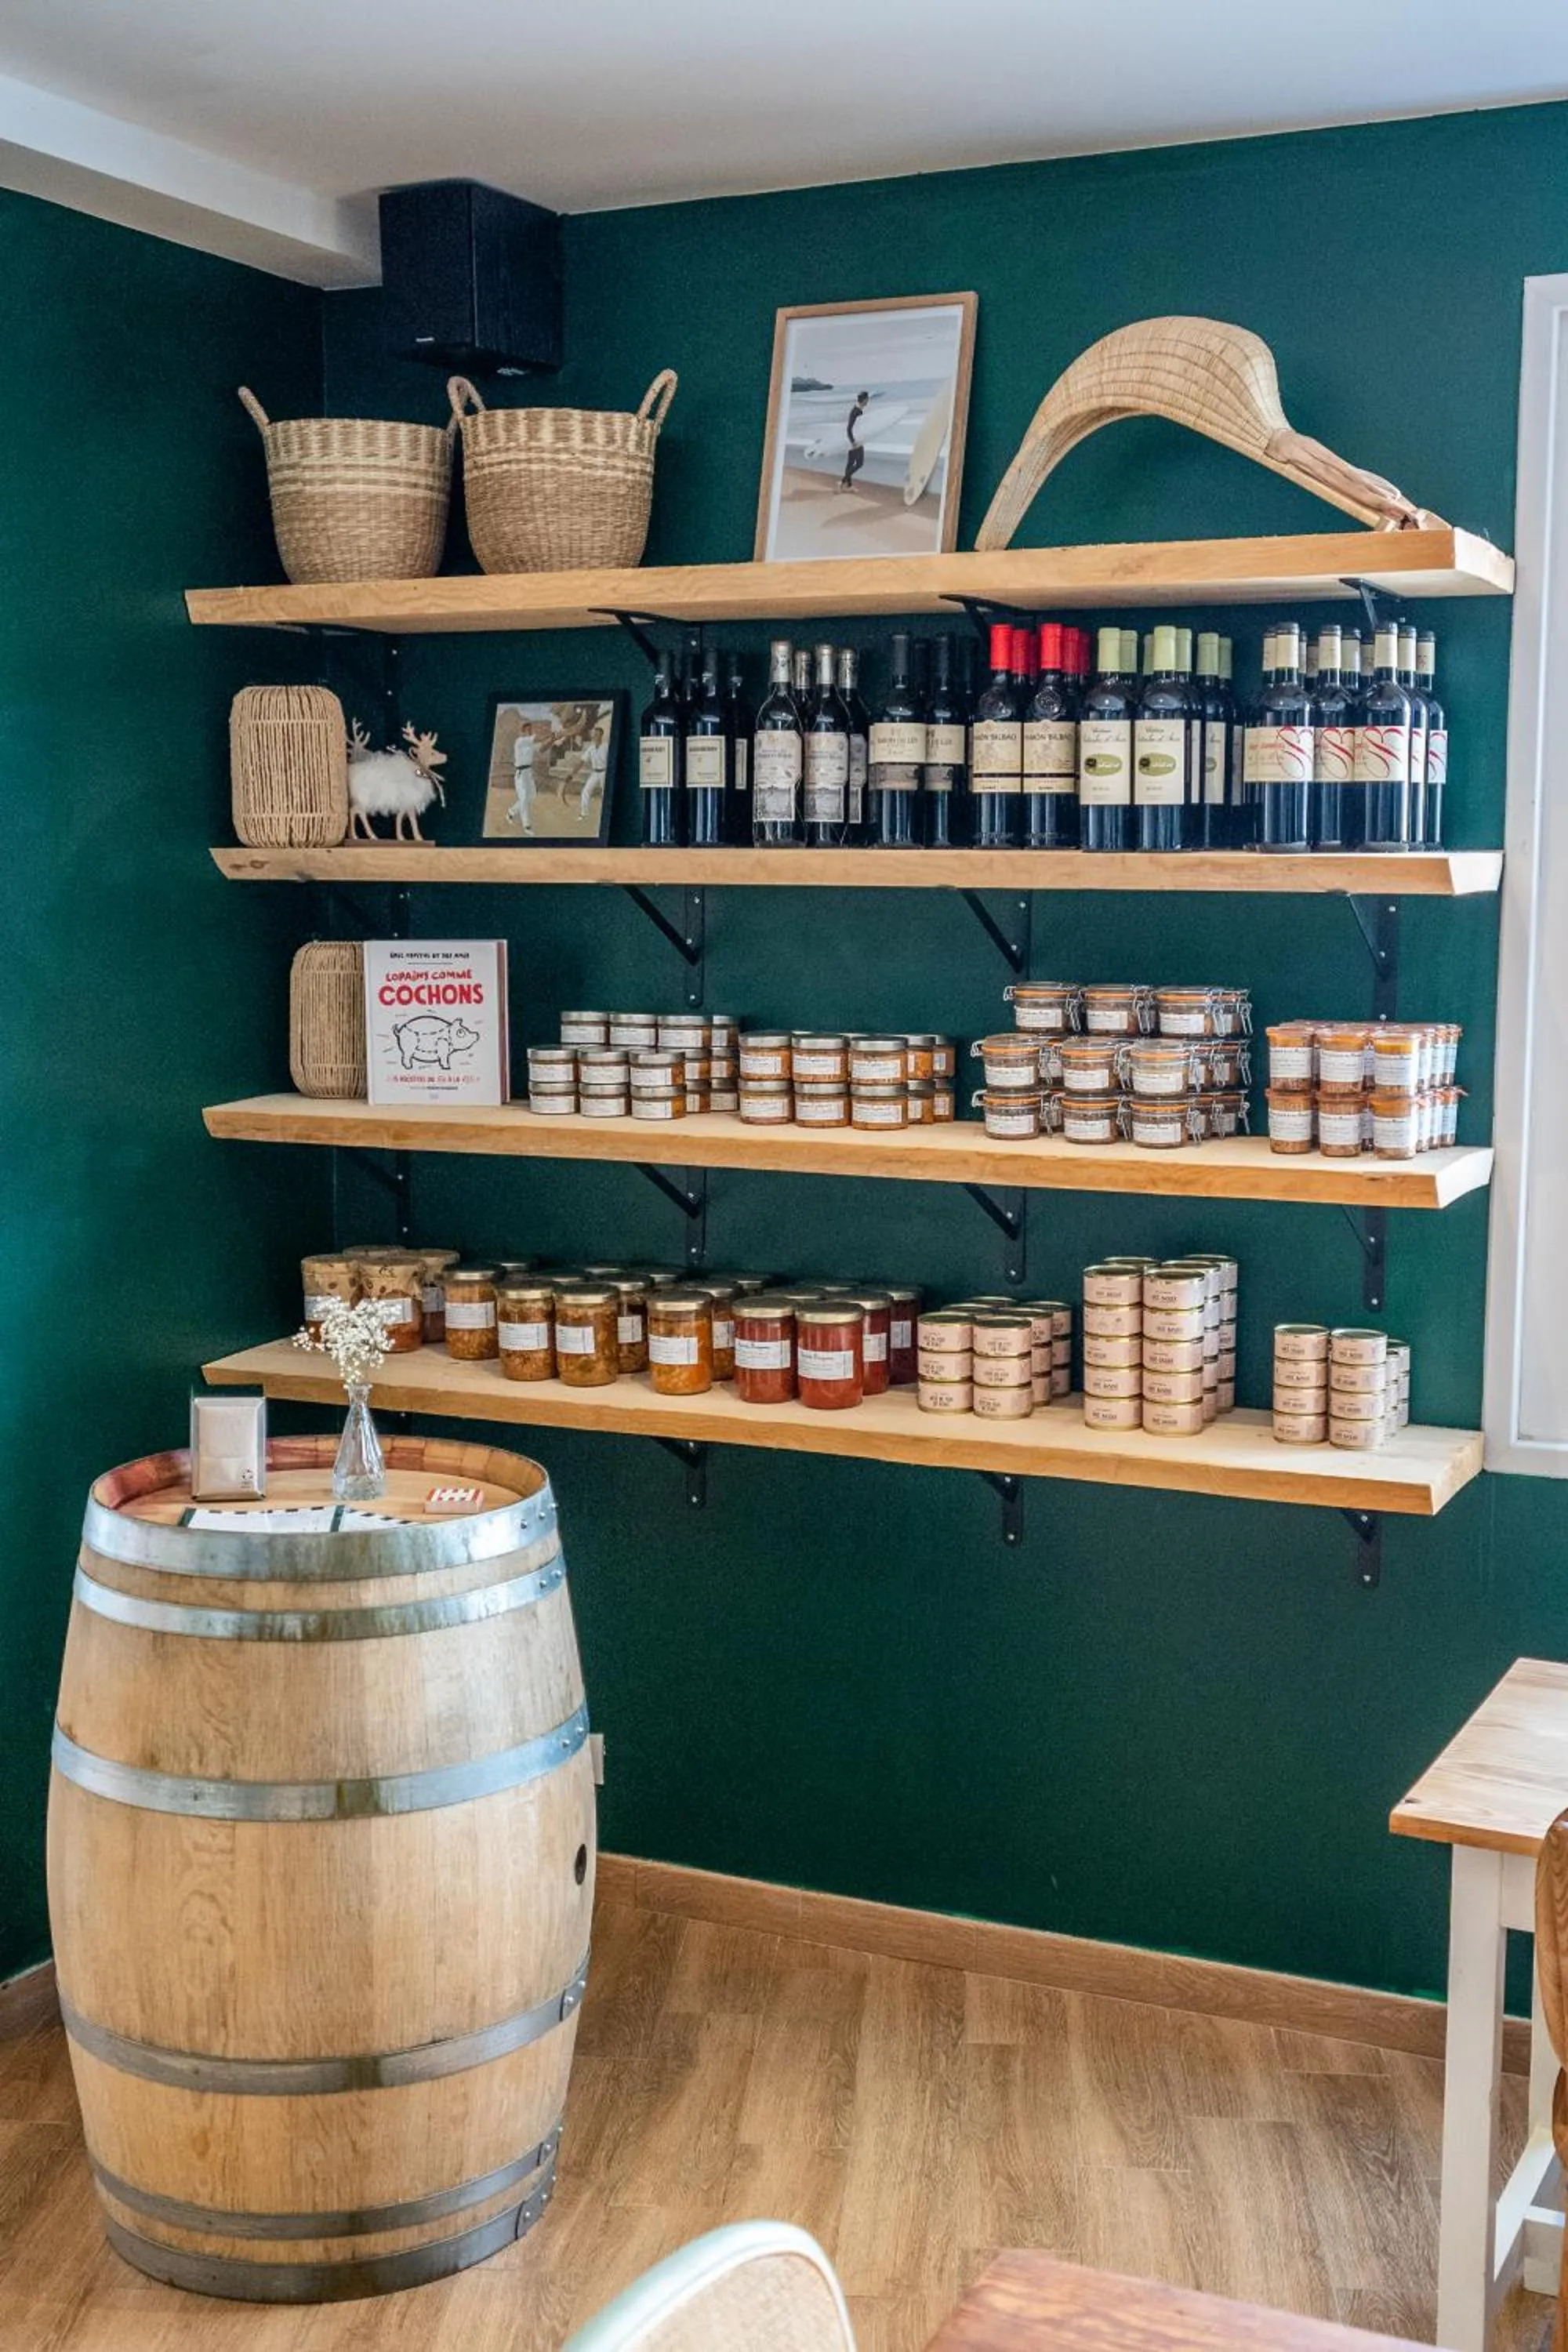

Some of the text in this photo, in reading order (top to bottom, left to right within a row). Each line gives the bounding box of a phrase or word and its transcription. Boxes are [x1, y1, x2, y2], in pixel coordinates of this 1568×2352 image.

[385, 968, 473, 982] COPAINS COMME
[379, 983, 484, 1005] COCHONS
